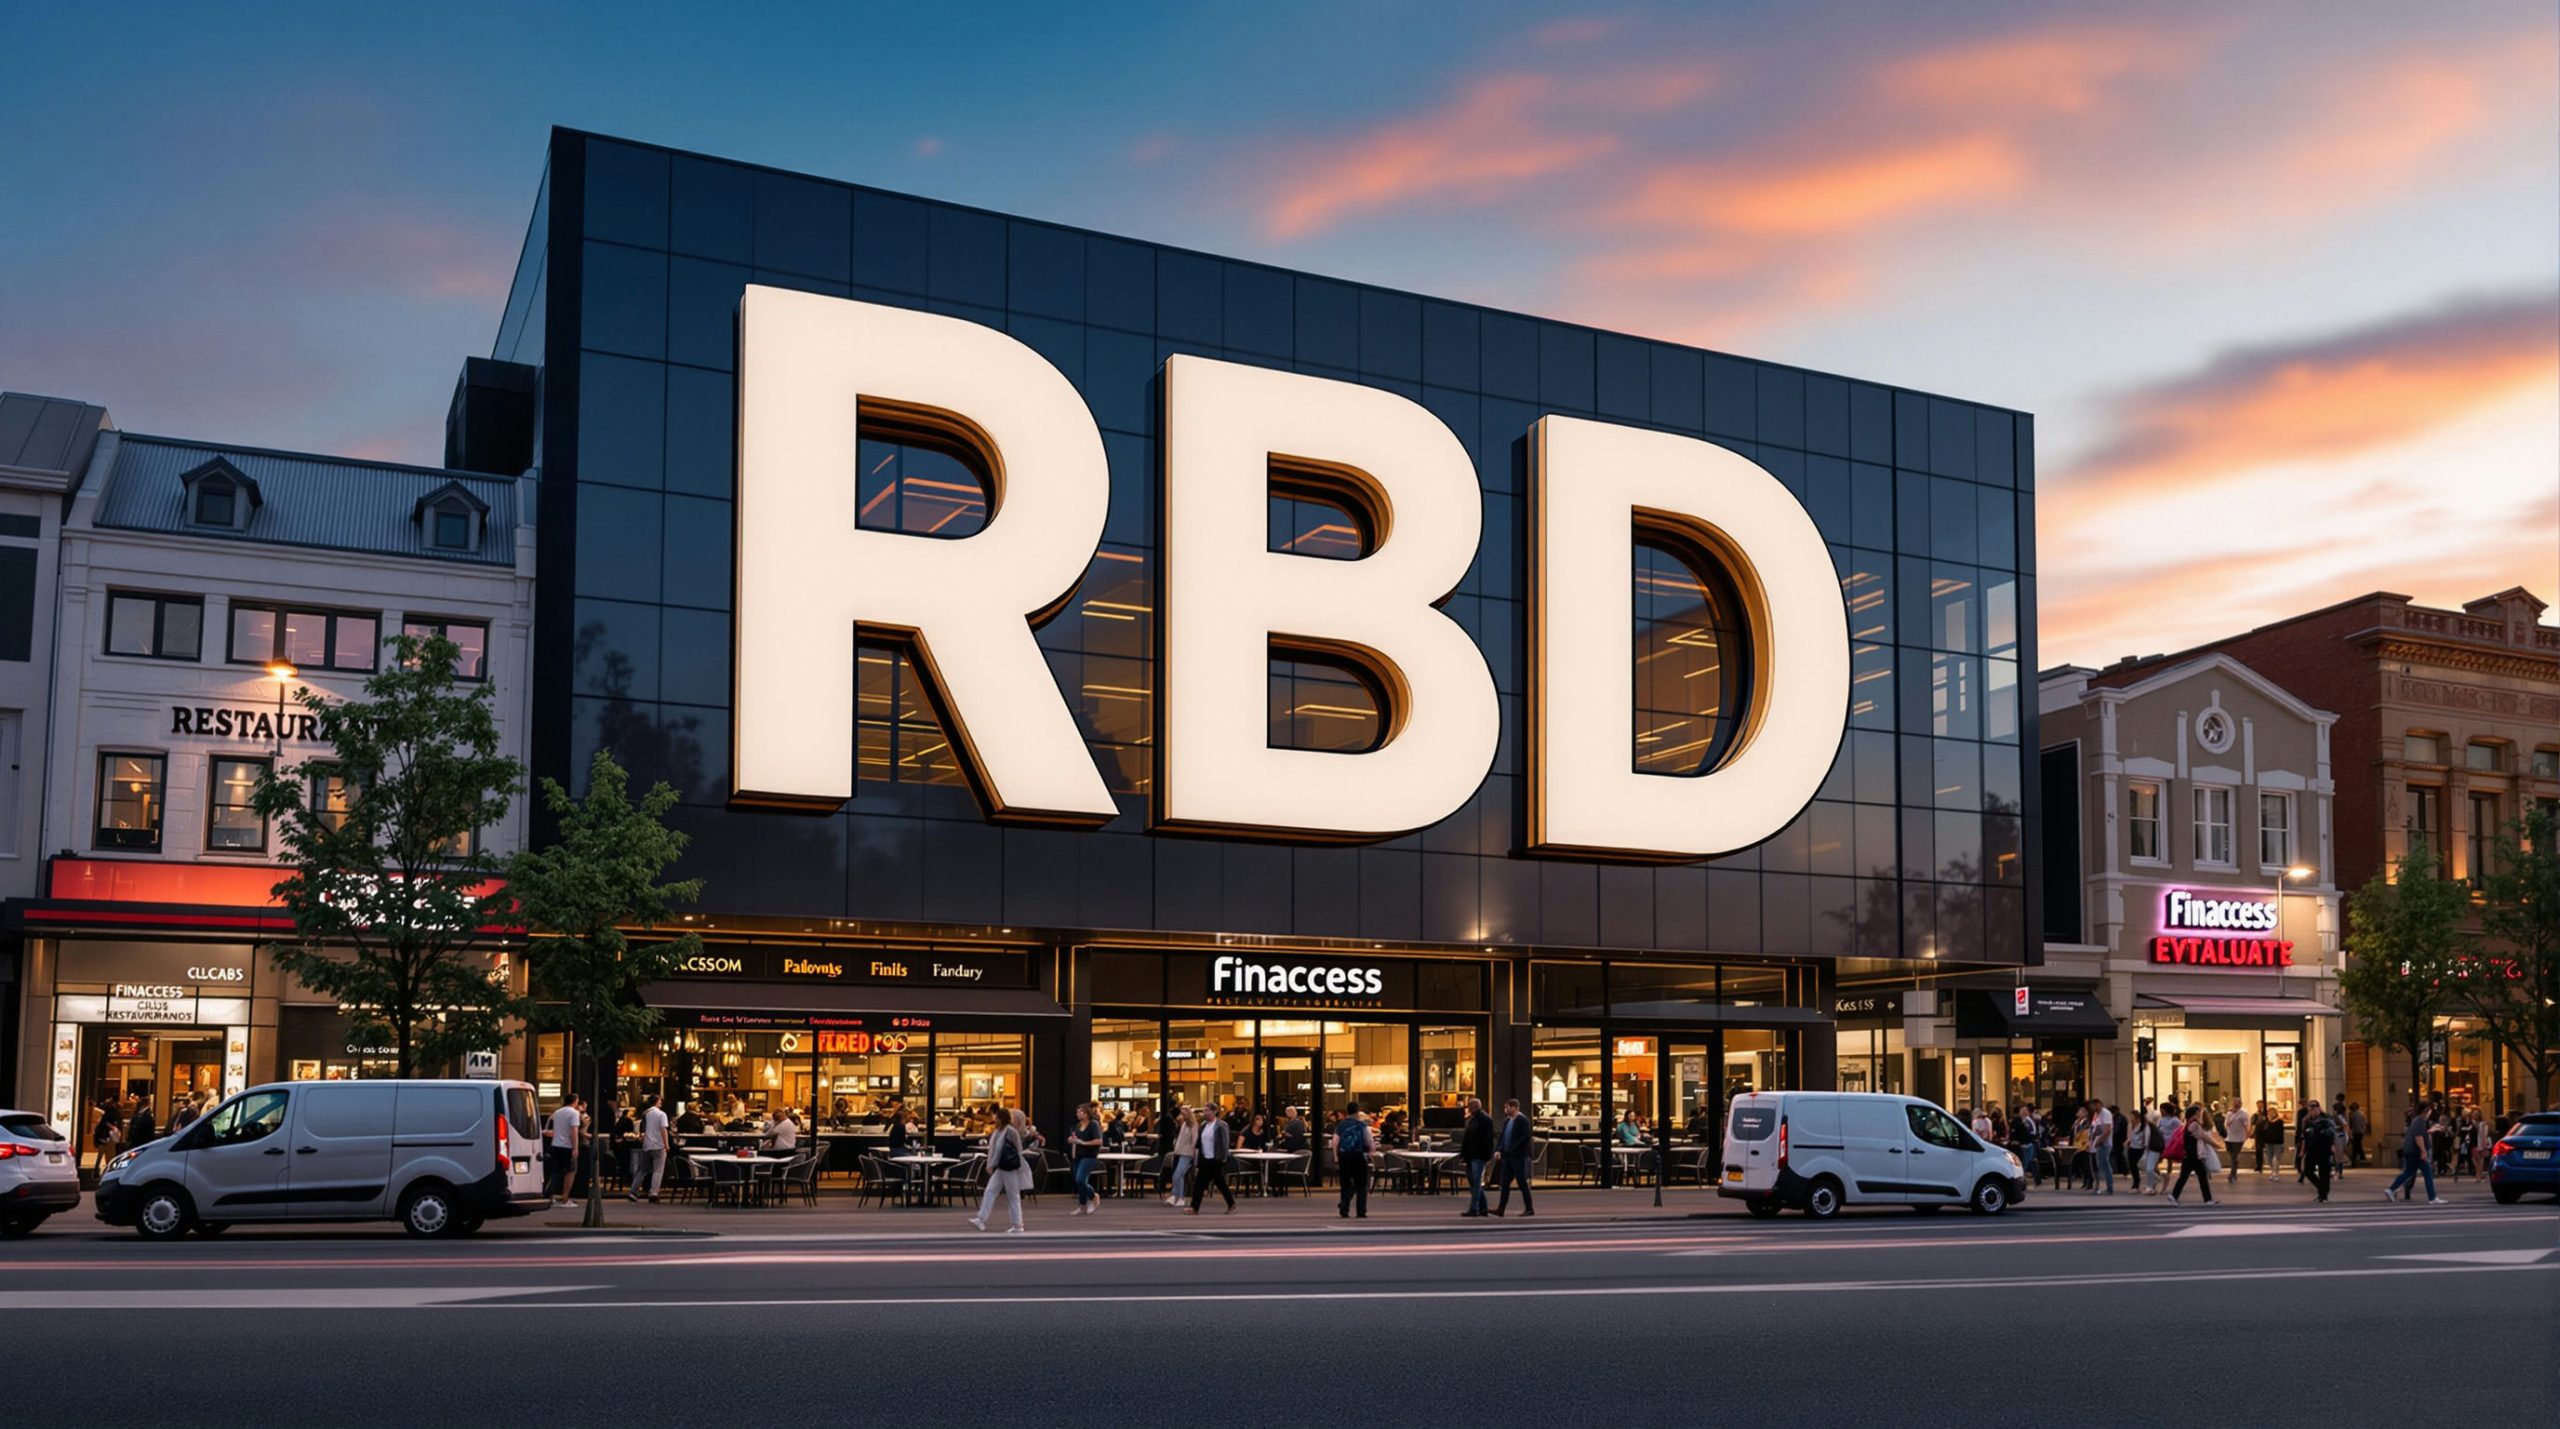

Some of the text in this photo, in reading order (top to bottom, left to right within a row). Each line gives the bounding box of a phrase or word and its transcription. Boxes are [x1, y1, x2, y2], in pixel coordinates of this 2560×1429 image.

[734, 284, 1852, 860] RBD
[2169, 890, 2279, 930] Finaccess
[2154, 936, 2295, 967] EVTALUATE
[115, 984, 184, 998] FINACCESS
[1214, 956, 1383, 994] Finaccess
